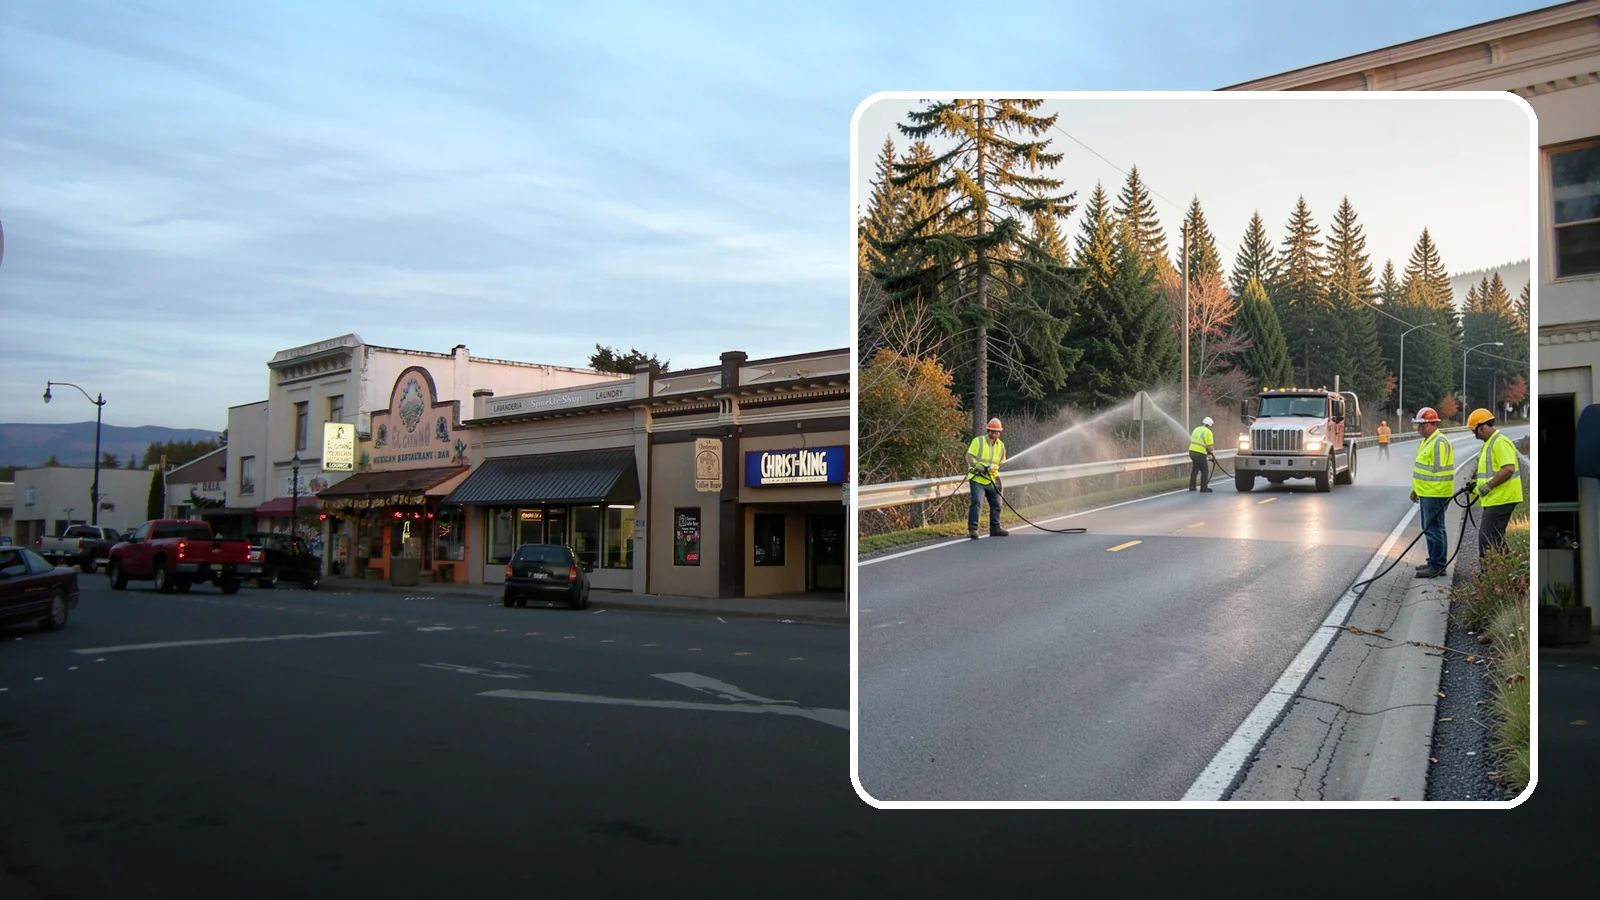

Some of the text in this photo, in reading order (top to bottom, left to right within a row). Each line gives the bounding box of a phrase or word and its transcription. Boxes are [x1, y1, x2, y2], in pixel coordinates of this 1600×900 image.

[595, 388, 624, 400] LAUNDRY
[493, 402, 522, 412] LAVANDERIA
[531, 394, 583, 409] Sparkle Shop
[373, 454, 396, 464] MEXICAN
[397, 451, 434, 462] RESTAURANT
[437, 450, 450, 459] BAR
[697, 480, 722, 489] Coffee House
